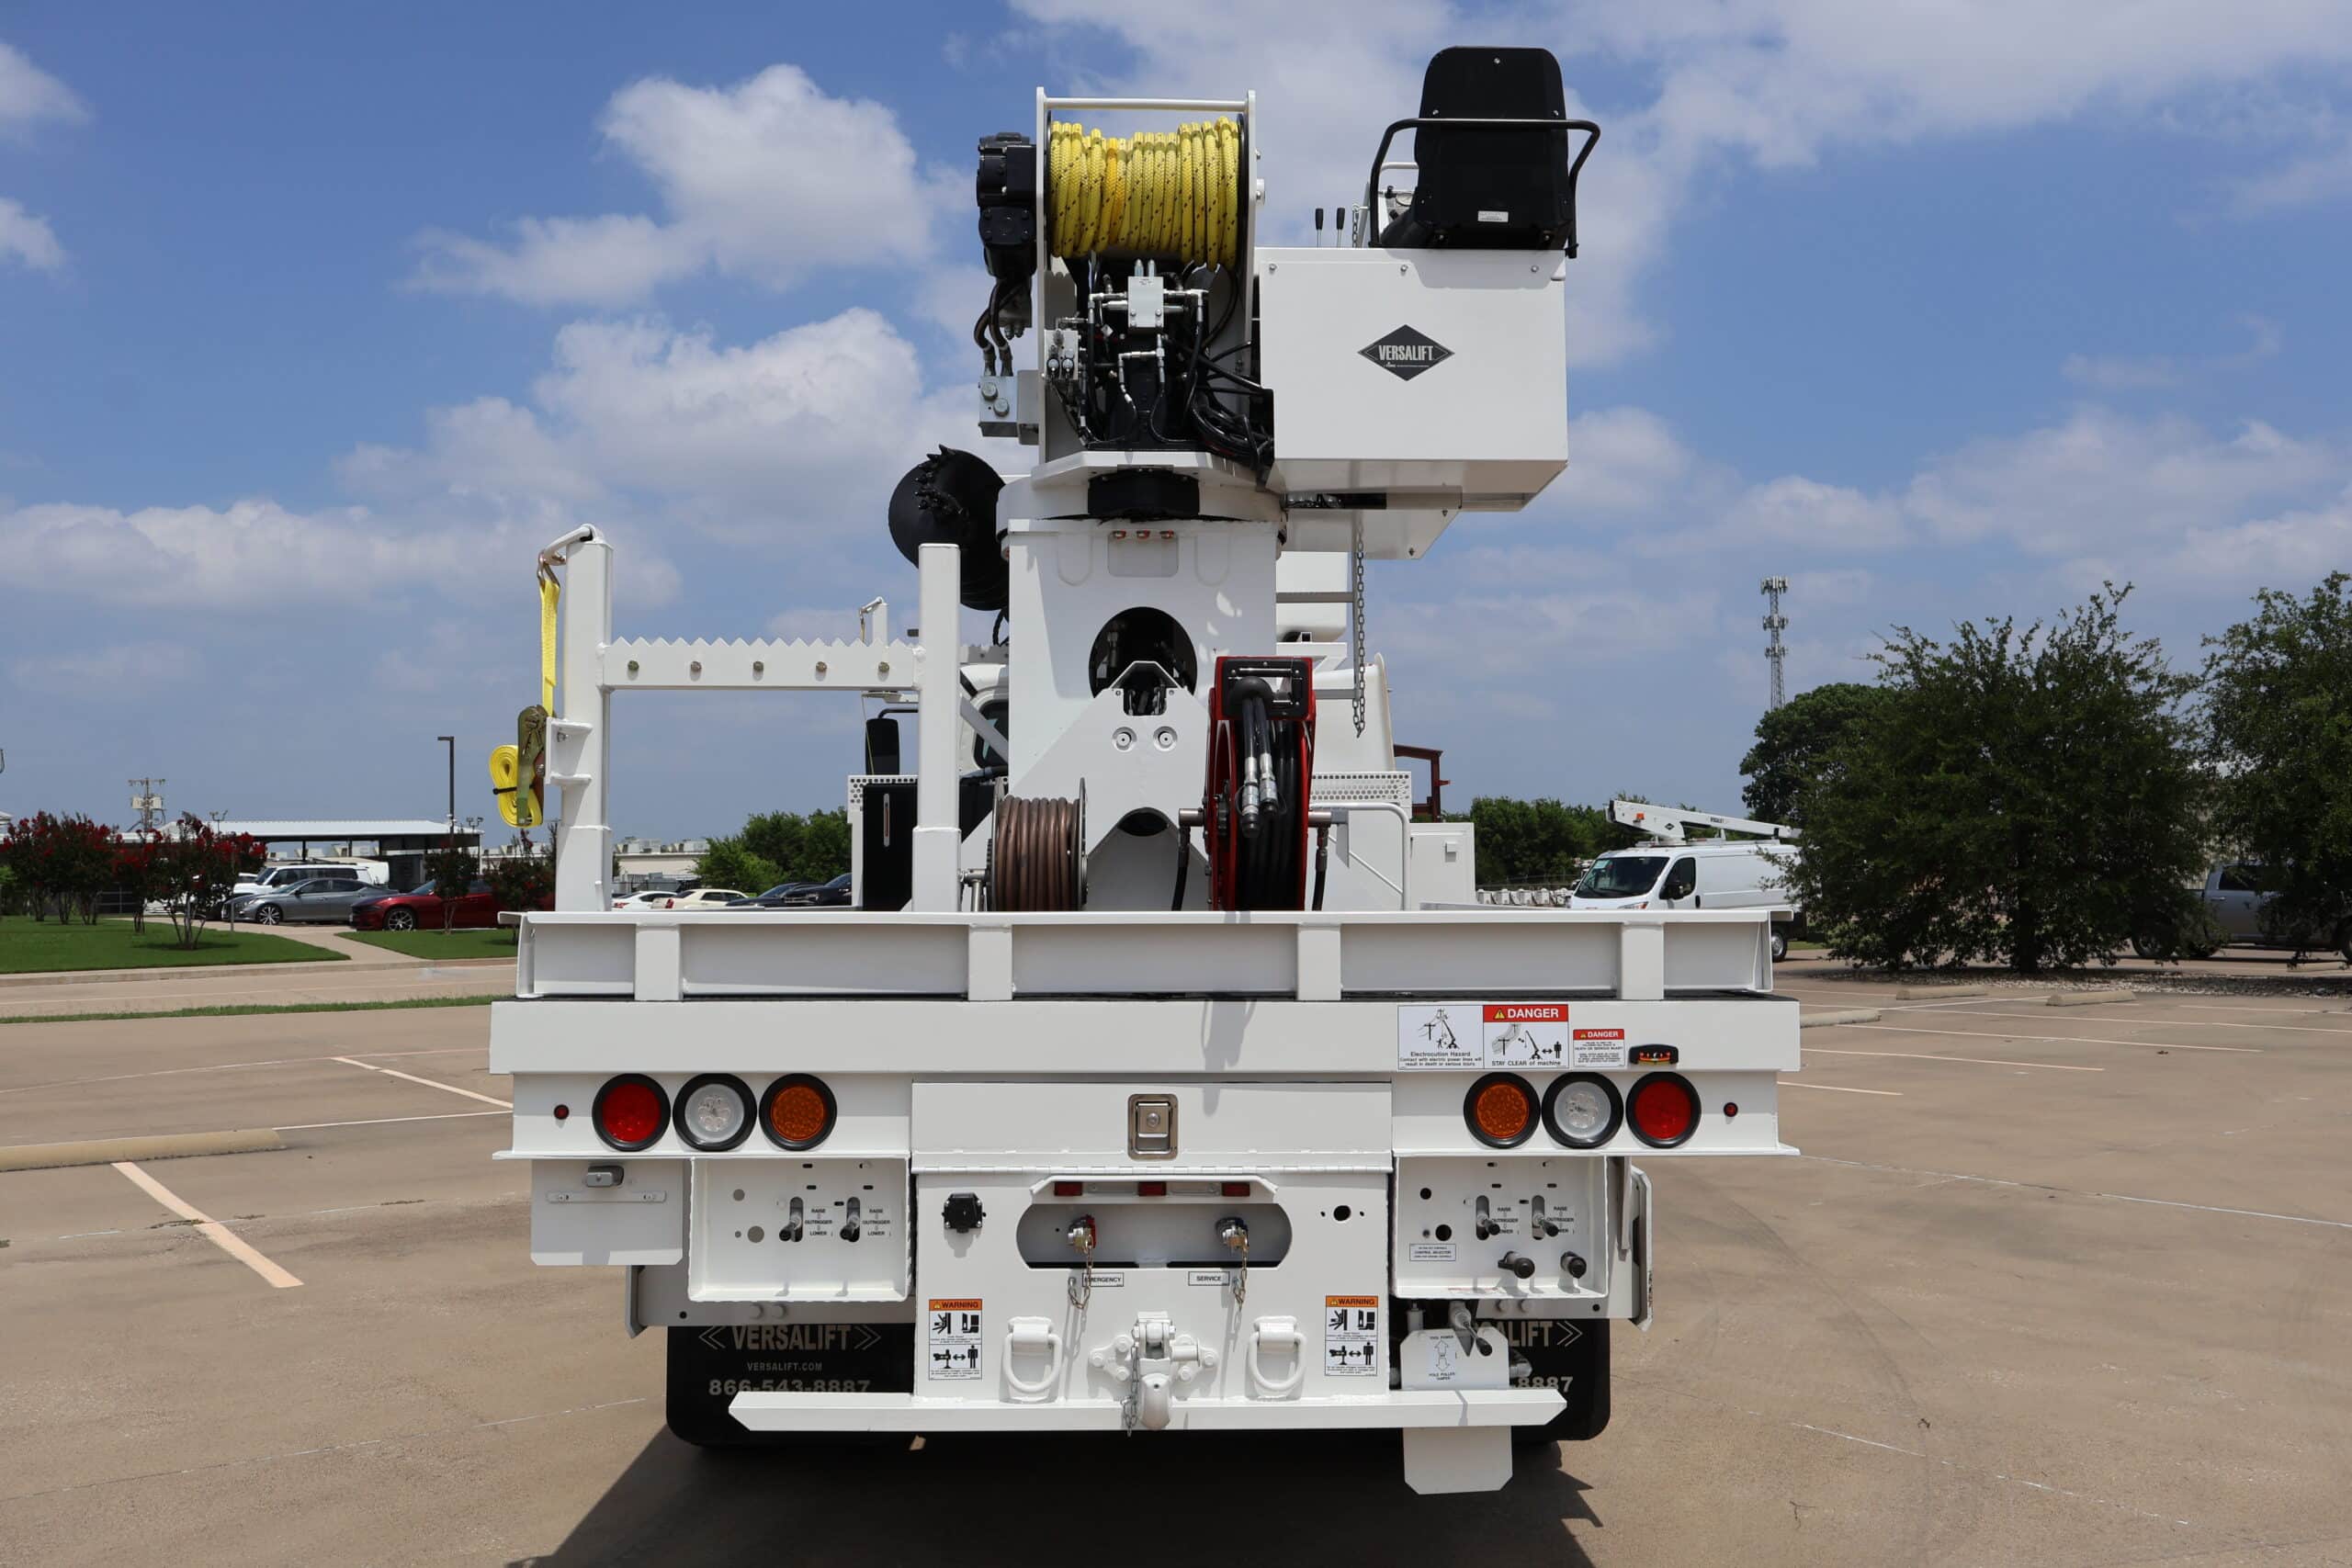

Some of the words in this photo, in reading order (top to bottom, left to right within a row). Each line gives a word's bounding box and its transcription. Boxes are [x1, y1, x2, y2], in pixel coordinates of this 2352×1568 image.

[1378, 344, 1433, 361] VERSALIFT
[1507, 1008, 1559, 1019] DANGER
[941, 1301, 978, 1309] WARNING
[731, 1325, 852, 1350] VERSALIFT
[747, 1361, 823, 1371] VERSALIFT.COM
[708, 1379, 871, 1395] 866-543-8887
